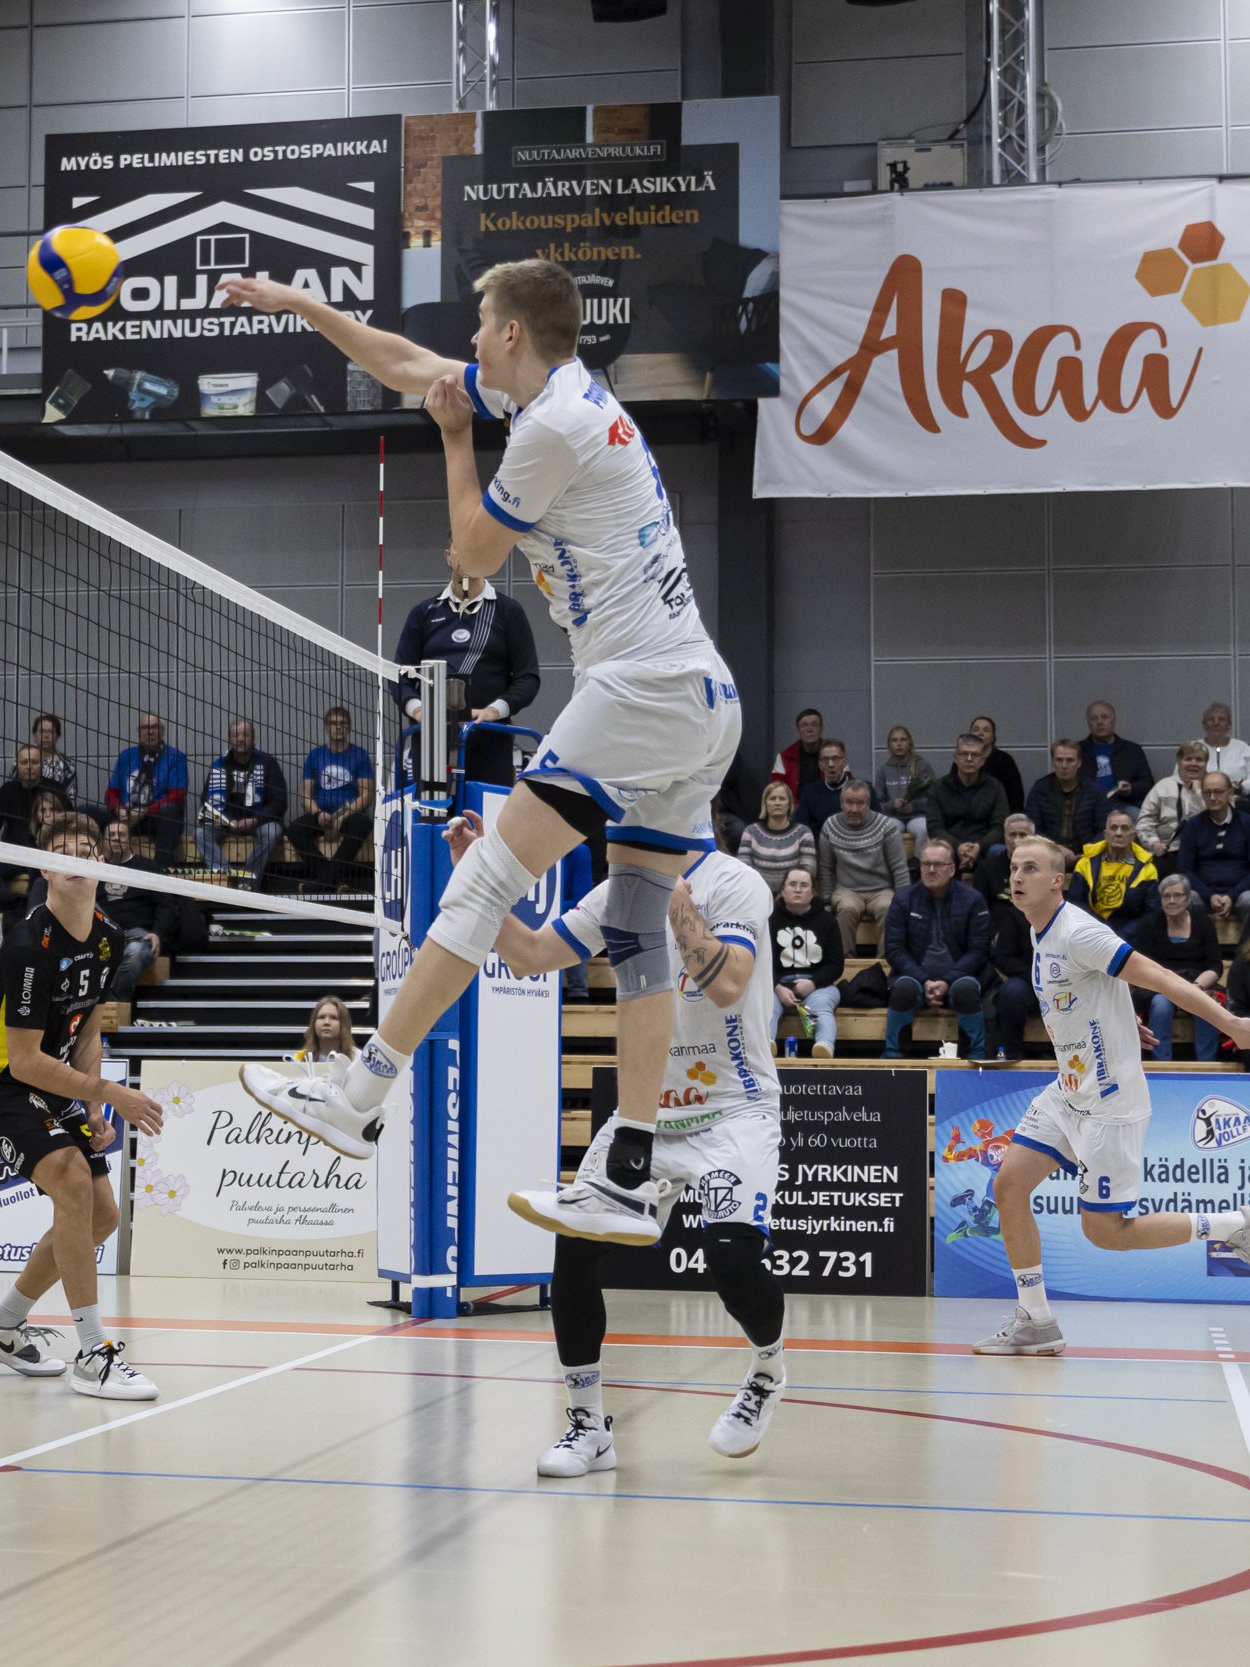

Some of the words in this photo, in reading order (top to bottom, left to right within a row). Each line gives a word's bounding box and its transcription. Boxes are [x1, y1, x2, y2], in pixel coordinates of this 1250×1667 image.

[60, 153, 114, 171] MYÖS
[119, 148, 244, 168] PELIMIESTEN
[250, 139, 388, 161] OSTOSPAIKKA!
[463, 177, 613, 201] NUUTAJÄRVEN
[617, 171, 717, 194] LASIKYLÄ
[479, 204, 700, 232] Kokouspalveluiden
[70, 314, 319, 342] RAKENNUSTARVIK
[795, 253, 1203, 449] Akaa
[21, 967, 36, 1004] LOIMAA
[78, 969, 90, 997] 5
[780, 1083, 863, 1096] uotettavaa
[781, 1105, 882, 1126] uljetuspalvelua
[790, 1131, 804, 1151] yli
[808, 1133, 828, 1148] 60
[831, 1136, 878, 1149] vuotta
[1215, 1125, 1250, 1148] VOLLE
[215, 1155, 368, 1197] puutarha
[794, 1164, 899, 1186] JYRKINEN
[1143, 1156, 1230, 1184] kädellä
[1097, 1176, 1111, 1199] 6
[229, 1200, 273, 1212] Palveleva
[273, 1203, 284, 1215] ja
[287, 1202, 355, 1216] persoonallinen
[247, 1214, 291, 1227] puutarha
[294, 1214, 335, 1226] Akaassa
[216, 1246, 364, 1259] www.palkinpaanpuutarha.fi
[818, 1251, 873, 1278] 731
[243, 1259, 354, 1272] palkinpaanpuutarha
